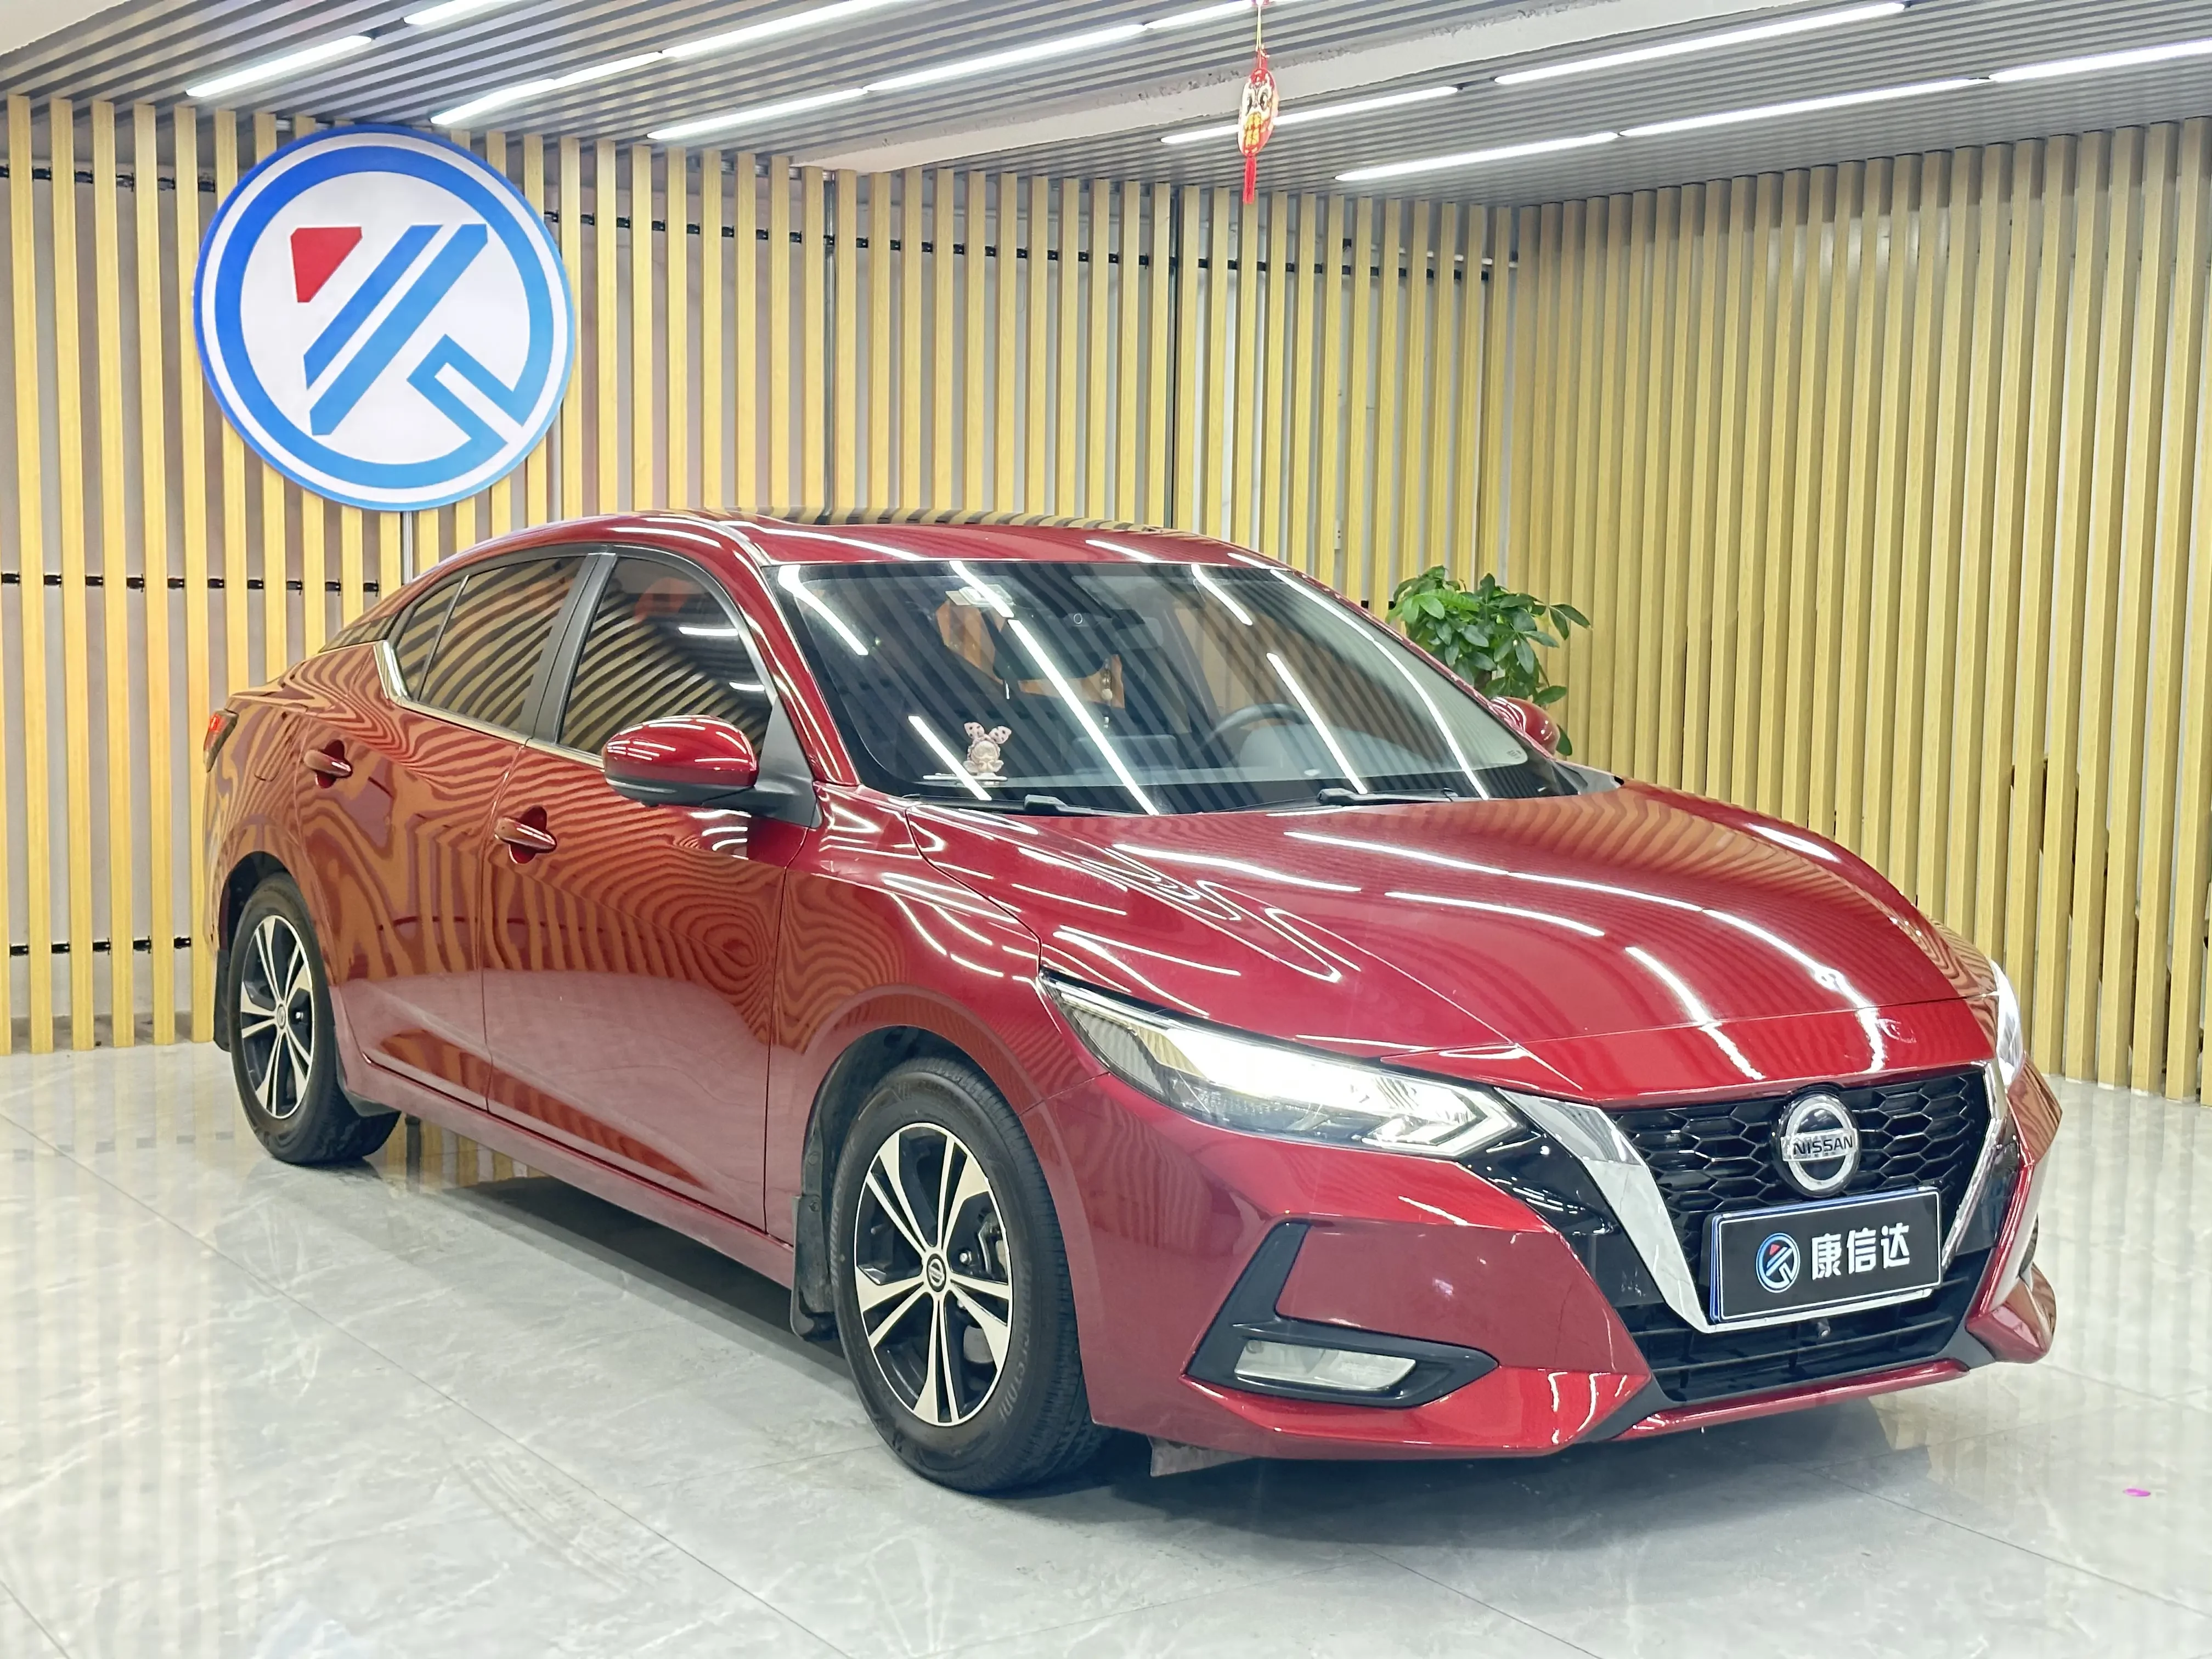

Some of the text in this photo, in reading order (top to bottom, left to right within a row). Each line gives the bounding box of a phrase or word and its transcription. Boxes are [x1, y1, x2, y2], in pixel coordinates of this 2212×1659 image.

[1793, 1135, 1853, 1155] NISSAN
[1812, 1222, 1910, 1280] 康信达
